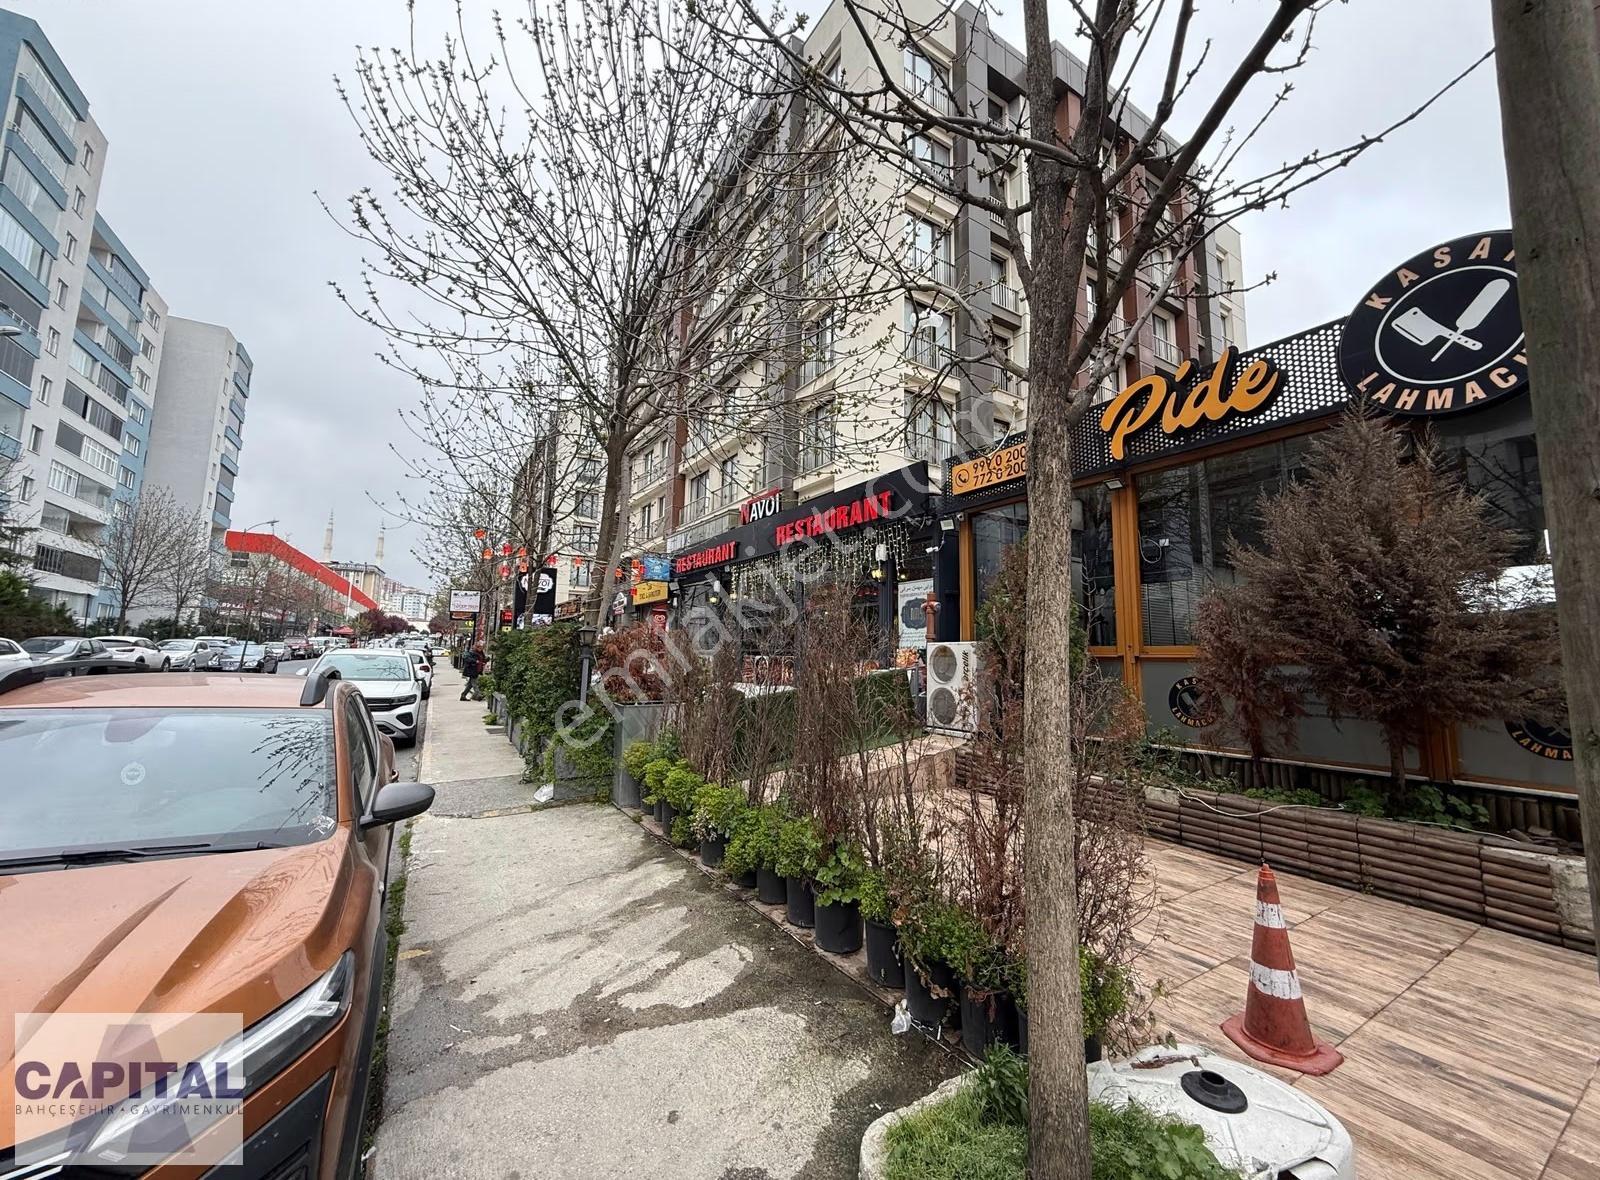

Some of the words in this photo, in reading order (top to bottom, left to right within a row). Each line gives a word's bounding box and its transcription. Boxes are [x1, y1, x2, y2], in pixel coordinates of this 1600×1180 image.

[1101, 348, 1280, 461] Pide
[775, 491, 893, 546] RESTAURANT
[675, 541, 736, 573] RESTAURANT
[1511, 730, 1573, 760] LAHMA
